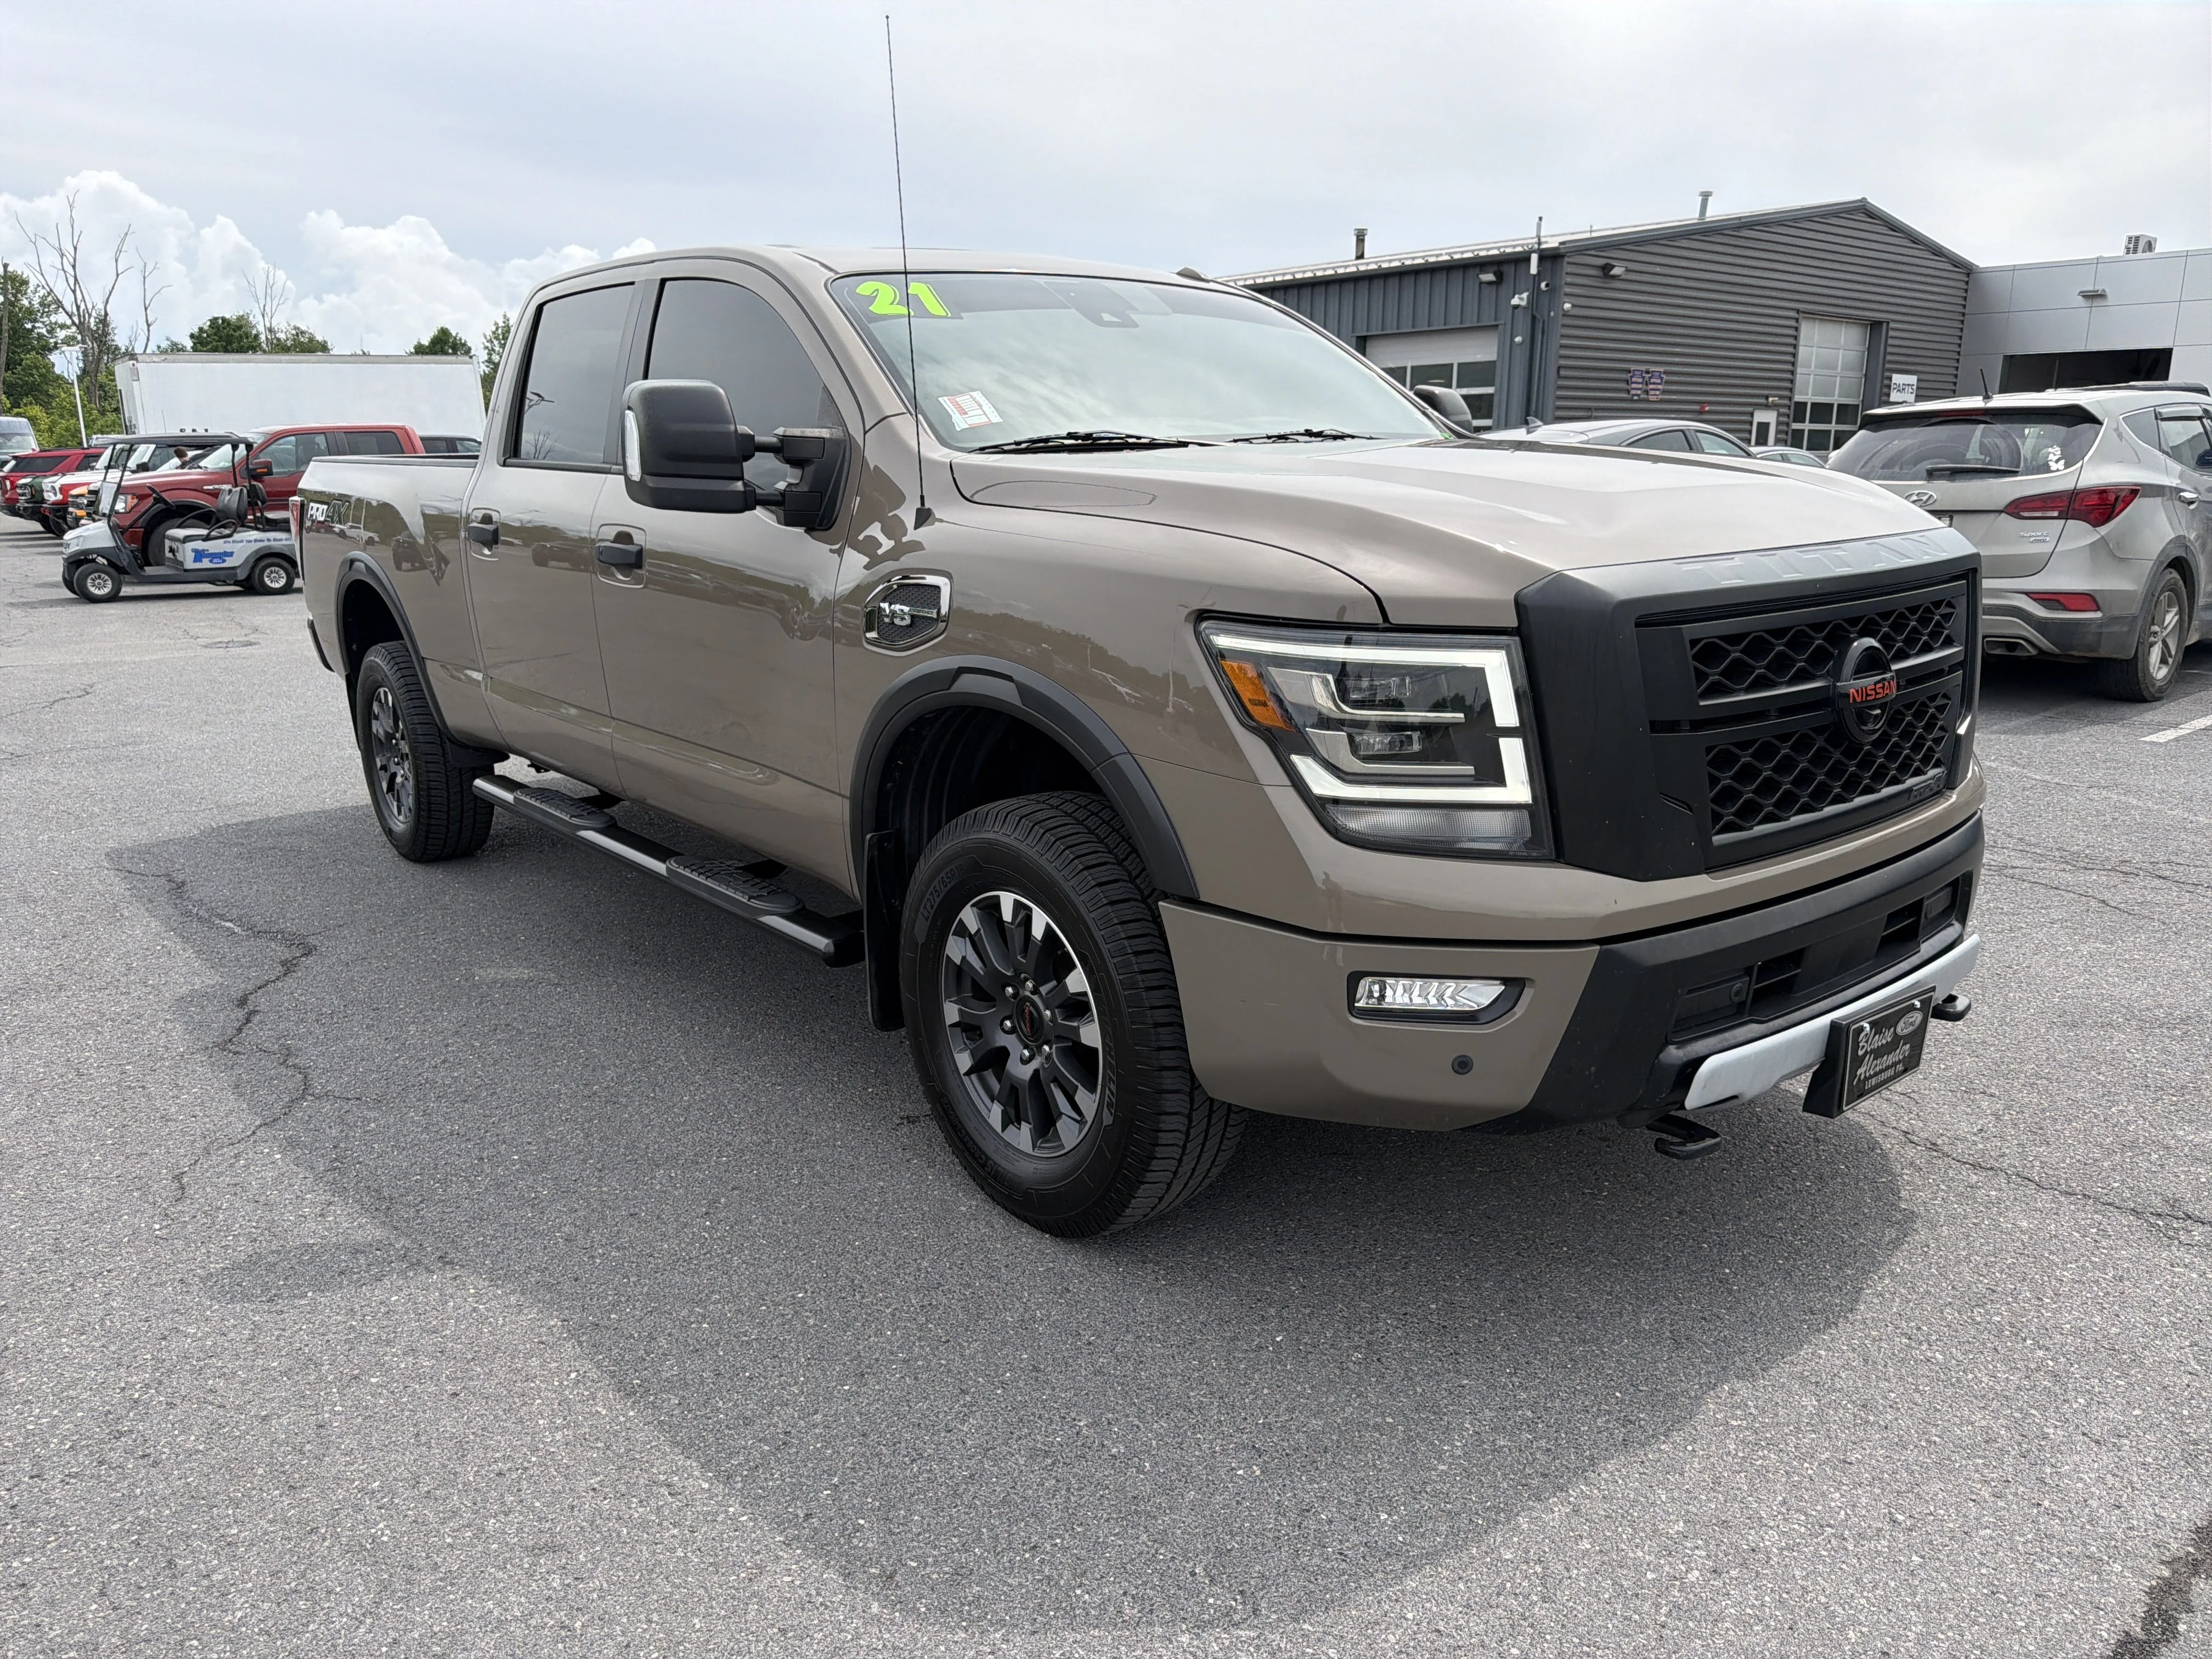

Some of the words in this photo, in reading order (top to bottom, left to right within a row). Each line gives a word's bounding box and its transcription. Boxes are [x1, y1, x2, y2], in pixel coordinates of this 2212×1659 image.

[856, 281, 951, 316] 21
[1892, 382, 1915, 394] PARTS
[1673, 534, 1950, 585] TITAN
[1849, 680, 1897, 703] NISSAN
[1858, 1027, 1894, 1056] Blaise
[1853, 1039, 1910, 1086] Alexander
[1865, 1066, 1895, 1090] LEWISBURG
